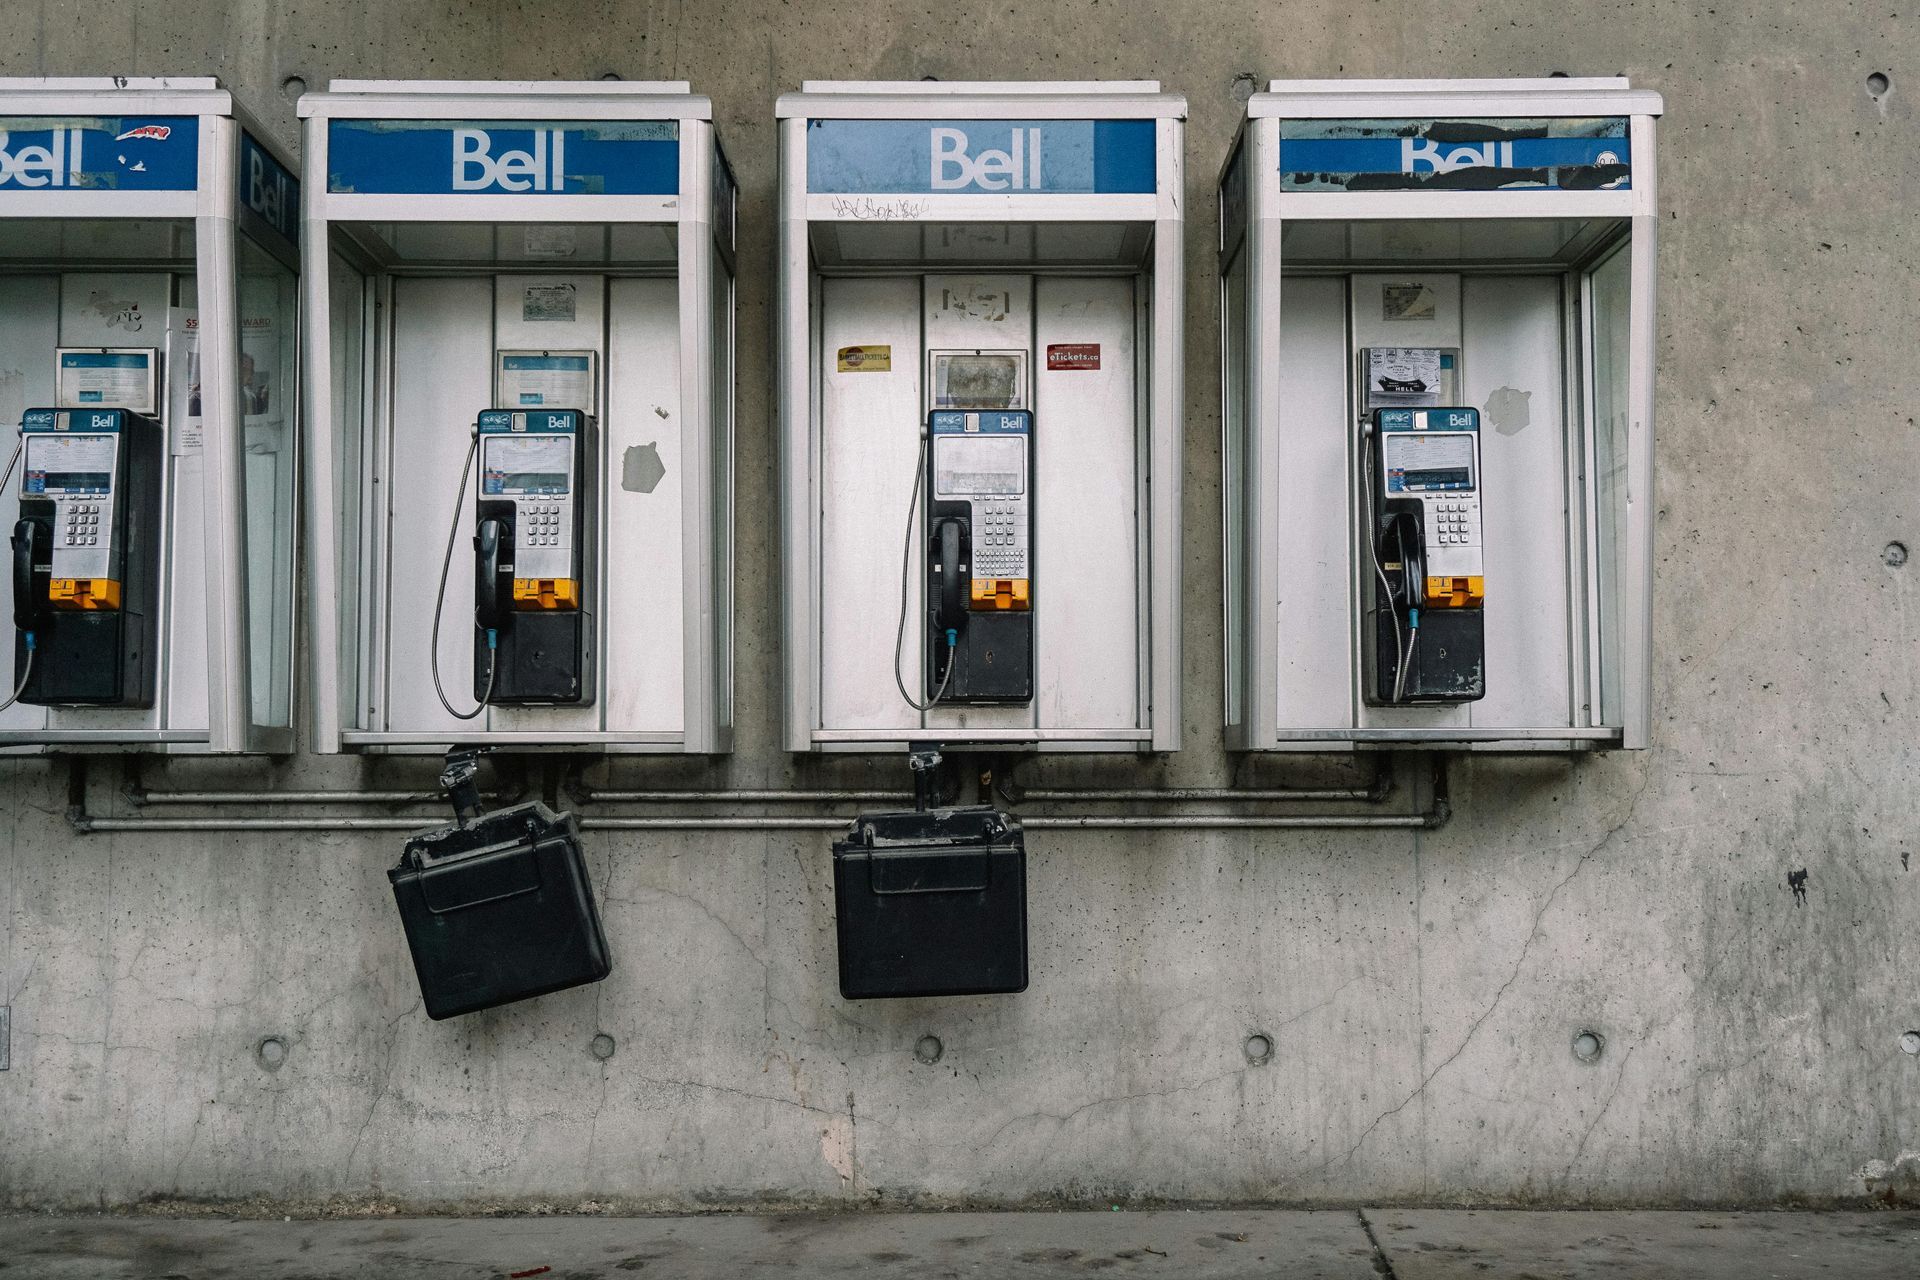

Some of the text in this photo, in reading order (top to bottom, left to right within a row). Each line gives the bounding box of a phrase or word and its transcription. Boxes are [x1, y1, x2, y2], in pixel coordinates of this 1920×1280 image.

[453, 129, 564, 191] Bell
[931, 127, 1041, 190] Bell
[250, 147, 286, 233] Bell
[1049, 351, 1099, 361] eTickets.ca
[91, 415, 114, 428] Bell
[548, 415, 570, 428] Bell
[1001, 416, 1023, 429] Bell
[1449, 413, 1472, 427] Bell
